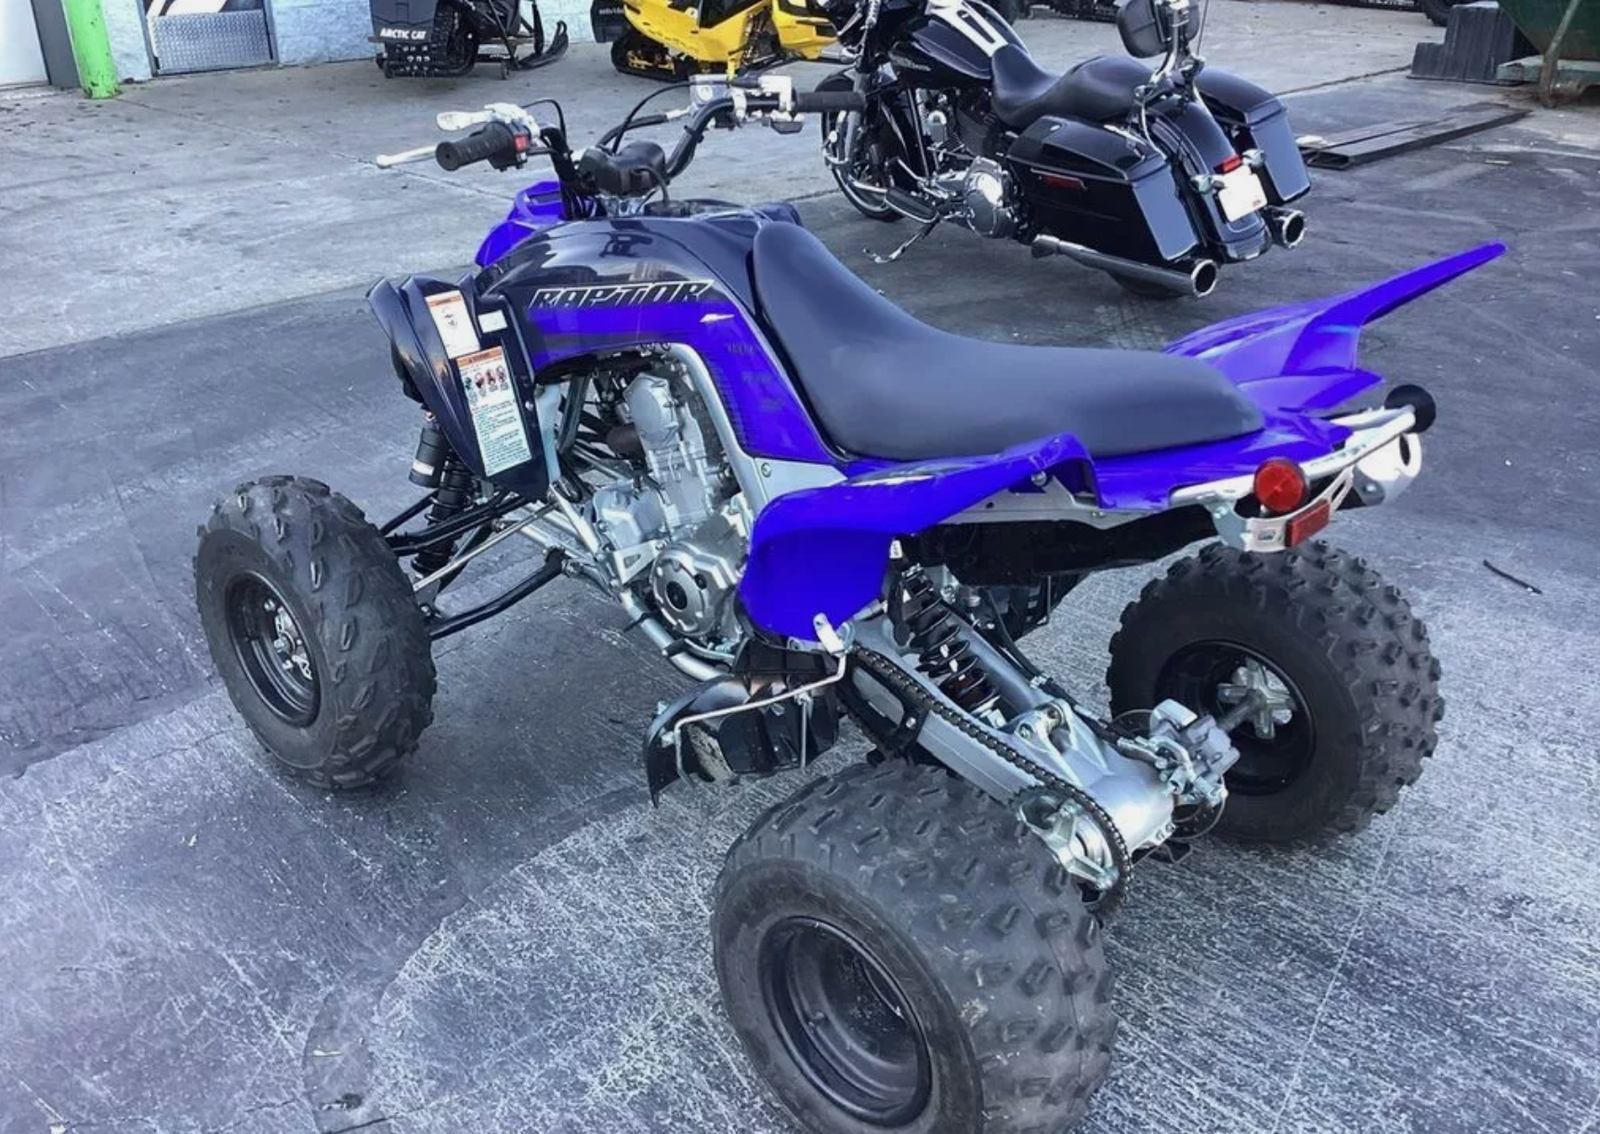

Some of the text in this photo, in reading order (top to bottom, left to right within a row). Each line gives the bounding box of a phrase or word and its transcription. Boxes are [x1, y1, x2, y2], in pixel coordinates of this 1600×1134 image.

[380, 27, 427, 39] ARCTIC CAT
[528, 279, 714, 310] RAPTOR
